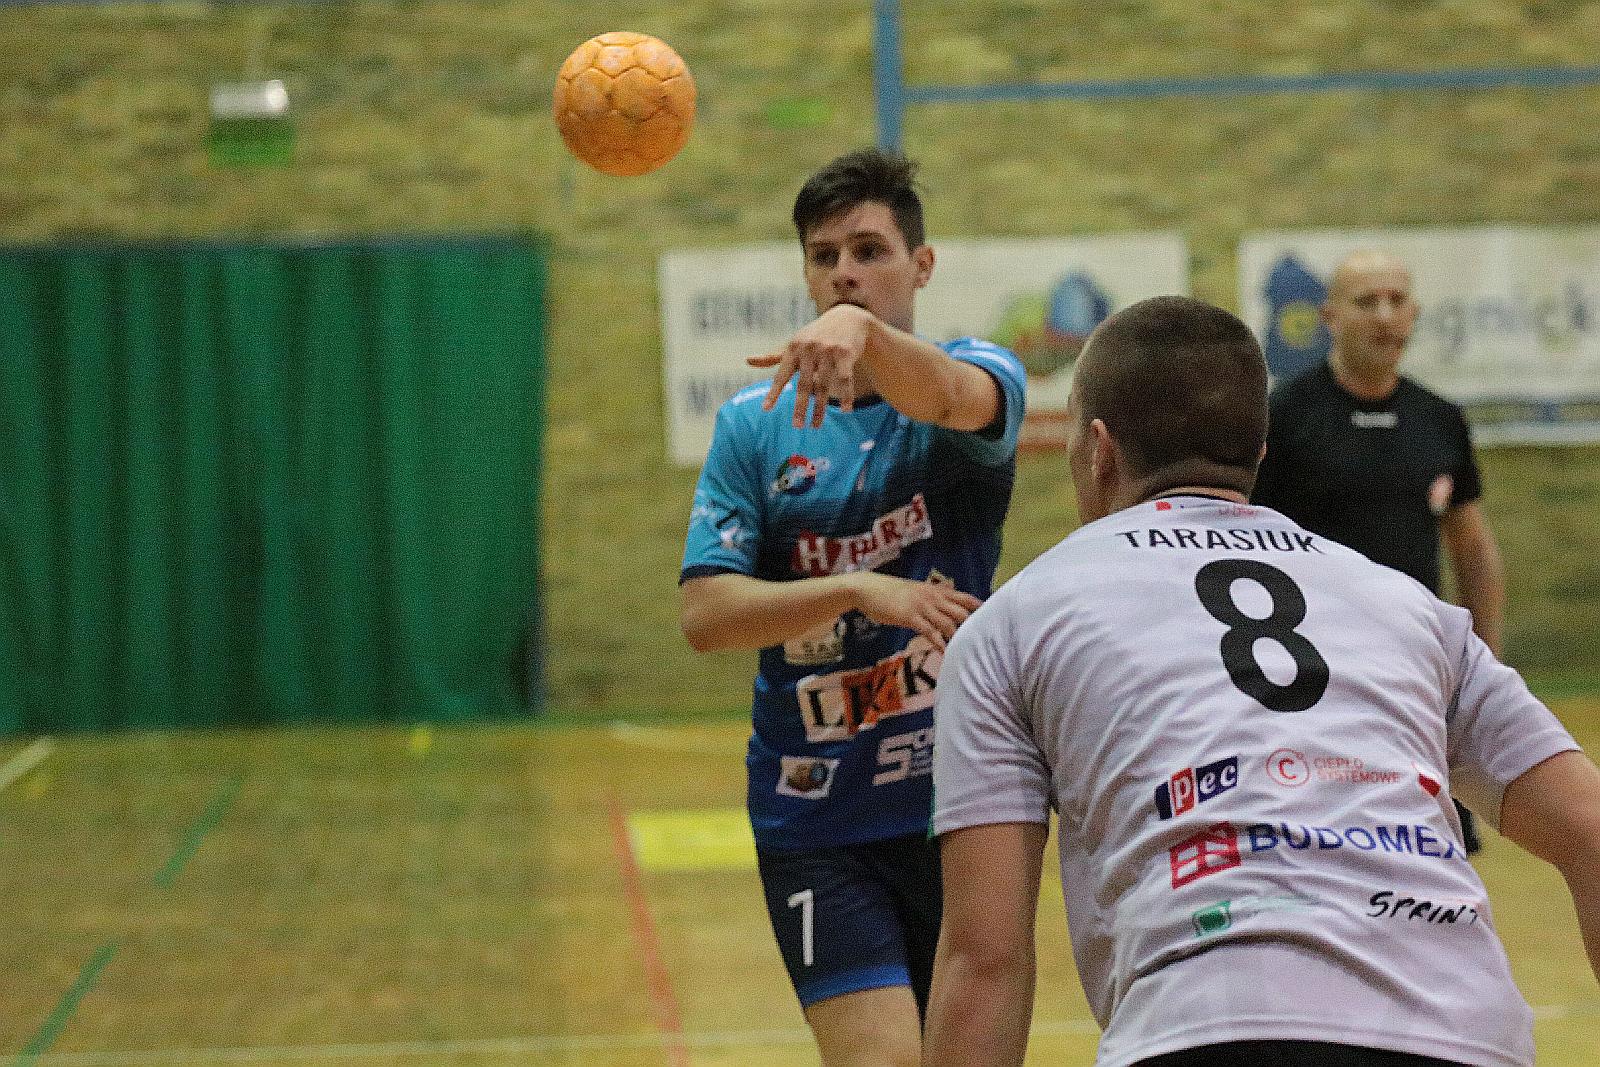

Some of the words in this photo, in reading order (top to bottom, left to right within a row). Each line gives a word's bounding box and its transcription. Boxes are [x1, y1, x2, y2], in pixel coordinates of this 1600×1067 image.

[1117, 528, 1325, 555] TARASIUK
[1195, 559, 1331, 713] 8
[1173, 764, 1236, 809] pec
